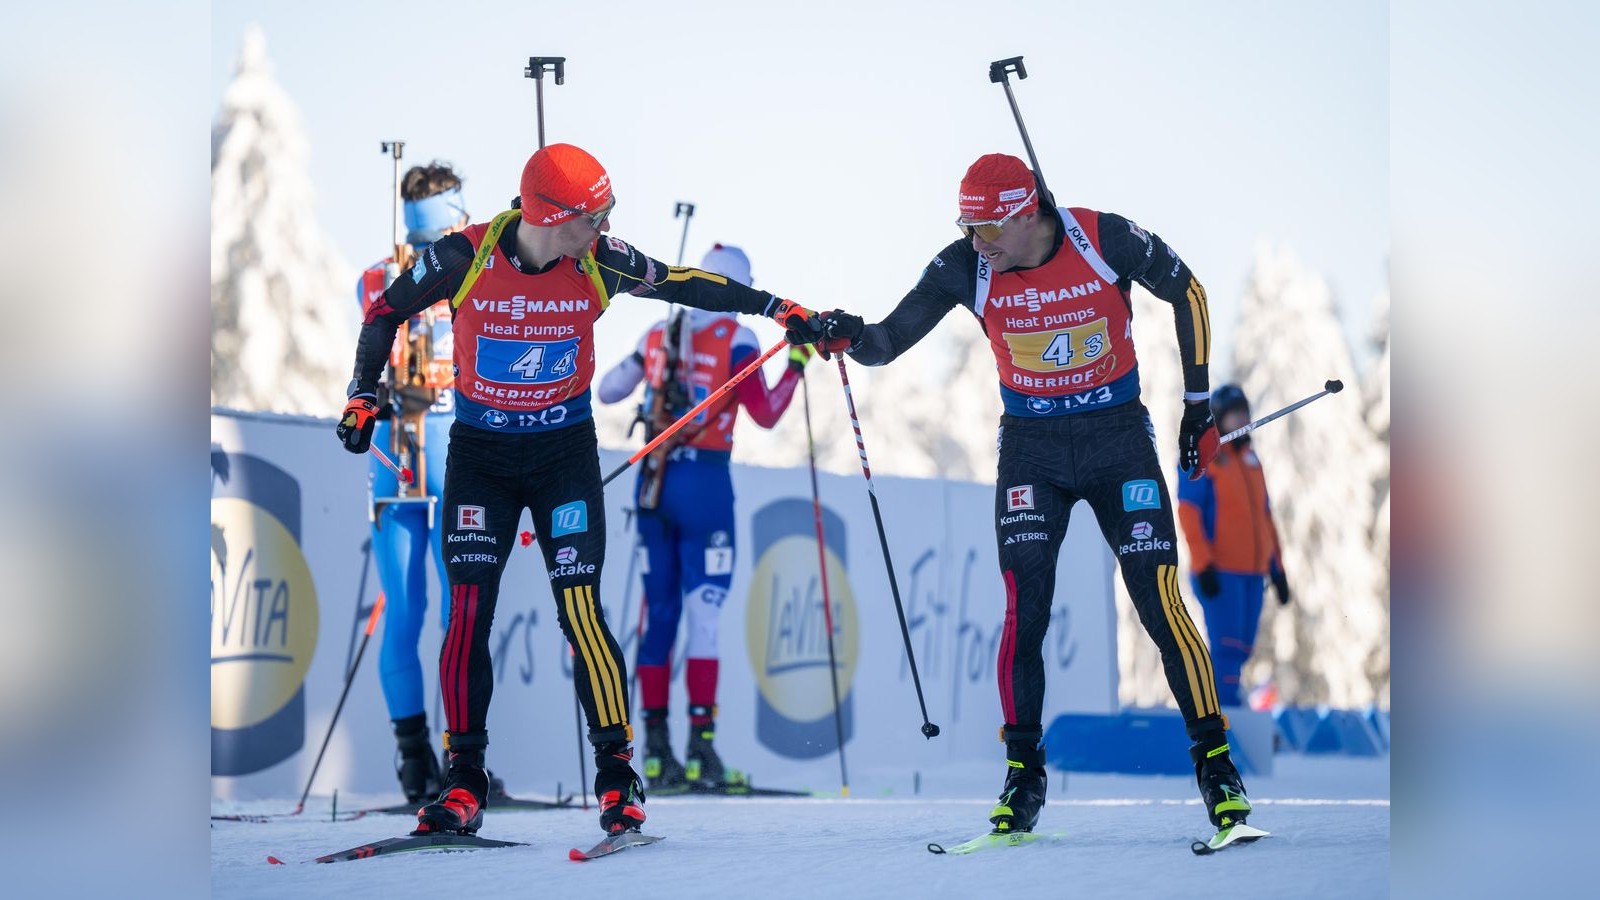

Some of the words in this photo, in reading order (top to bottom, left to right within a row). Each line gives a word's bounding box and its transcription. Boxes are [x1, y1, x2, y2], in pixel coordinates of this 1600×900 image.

[1068, 225, 1091, 252] JOKA
[990, 279, 1102, 313] VIESSMANN
[472, 295, 589, 320] VIESSMANN
[1006, 316, 1040, 328] Heat
[1044, 307, 1096, 328] pumps
[483, 322, 519, 335] Heat
[524, 324, 575, 337] pumps
[1042, 332, 1073, 367] 4
[1084, 333, 1104, 358] 3
[509, 345, 546, 380] 4
[551, 348, 575, 375] 4
[1013, 368, 1095, 388] OBERHOF
[474, 381, 557, 400] OBERHOF
[1128, 483, 1155, 505] TQ
[556, 506, 581, 530] TQ
[1000, 512, 1045, 526] Kaufland
[447, 532, 497, 544] Kaufland
[1015, 532, 1049, 543] TERREX
[462, 553, 498, 564] TERREX
